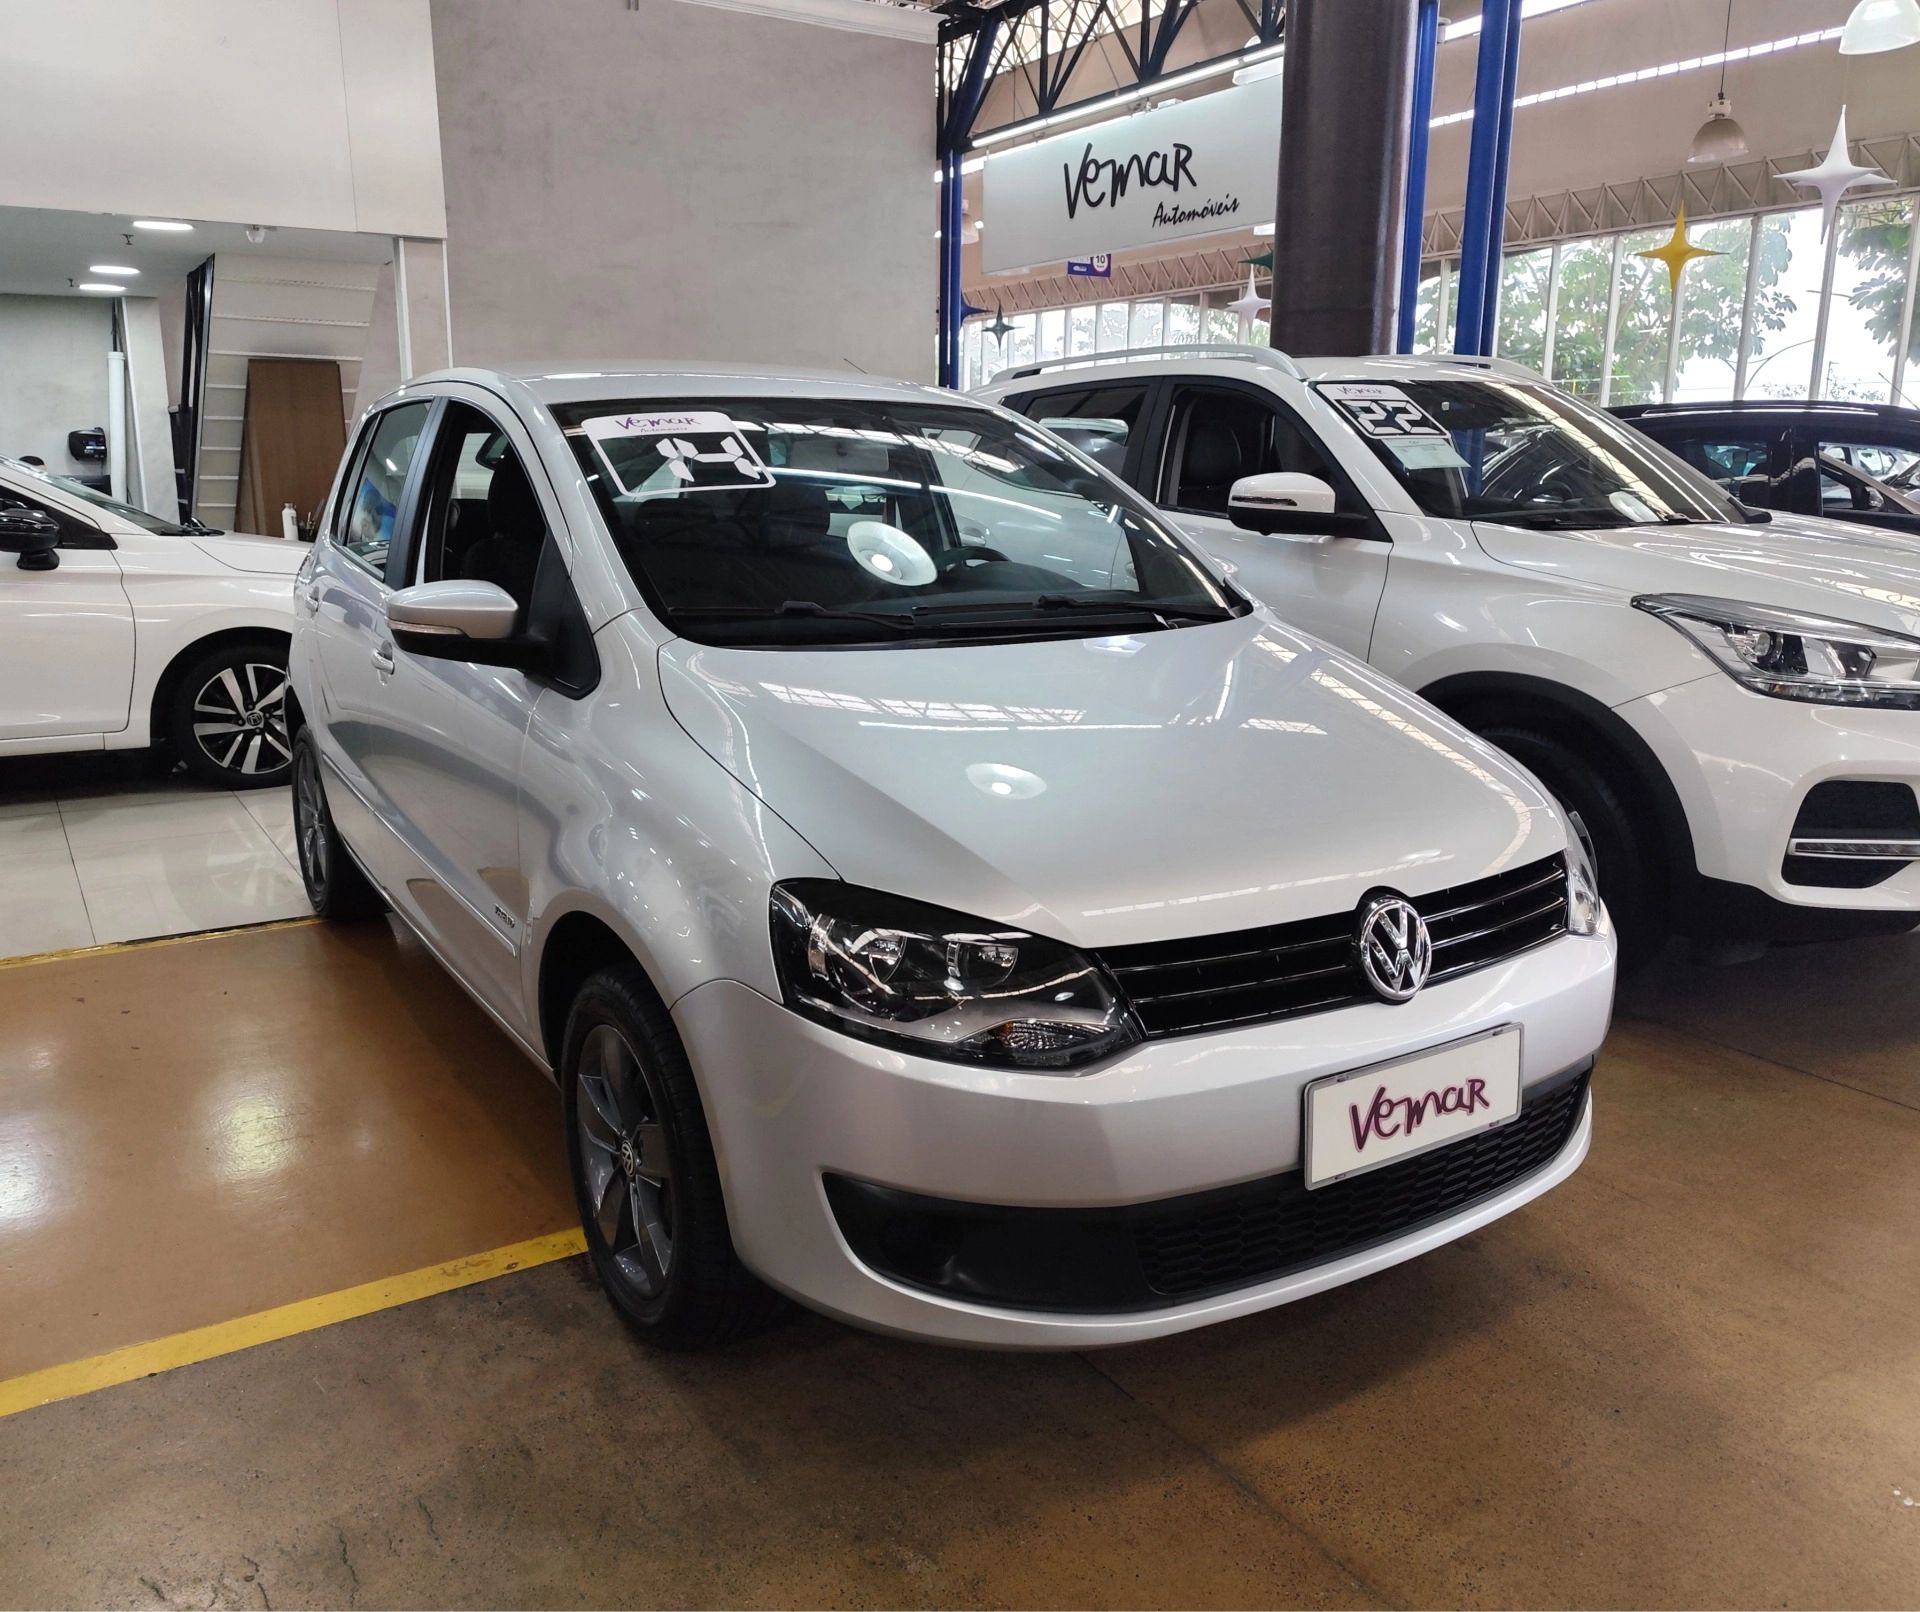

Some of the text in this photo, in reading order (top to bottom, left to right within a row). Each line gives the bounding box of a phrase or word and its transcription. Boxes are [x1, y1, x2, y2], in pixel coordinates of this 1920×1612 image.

[1152, 193, 1240, 228] Automóveis
[1095, 255, 1106, 264] 10
[1341, 400, 1441, 434] 22
